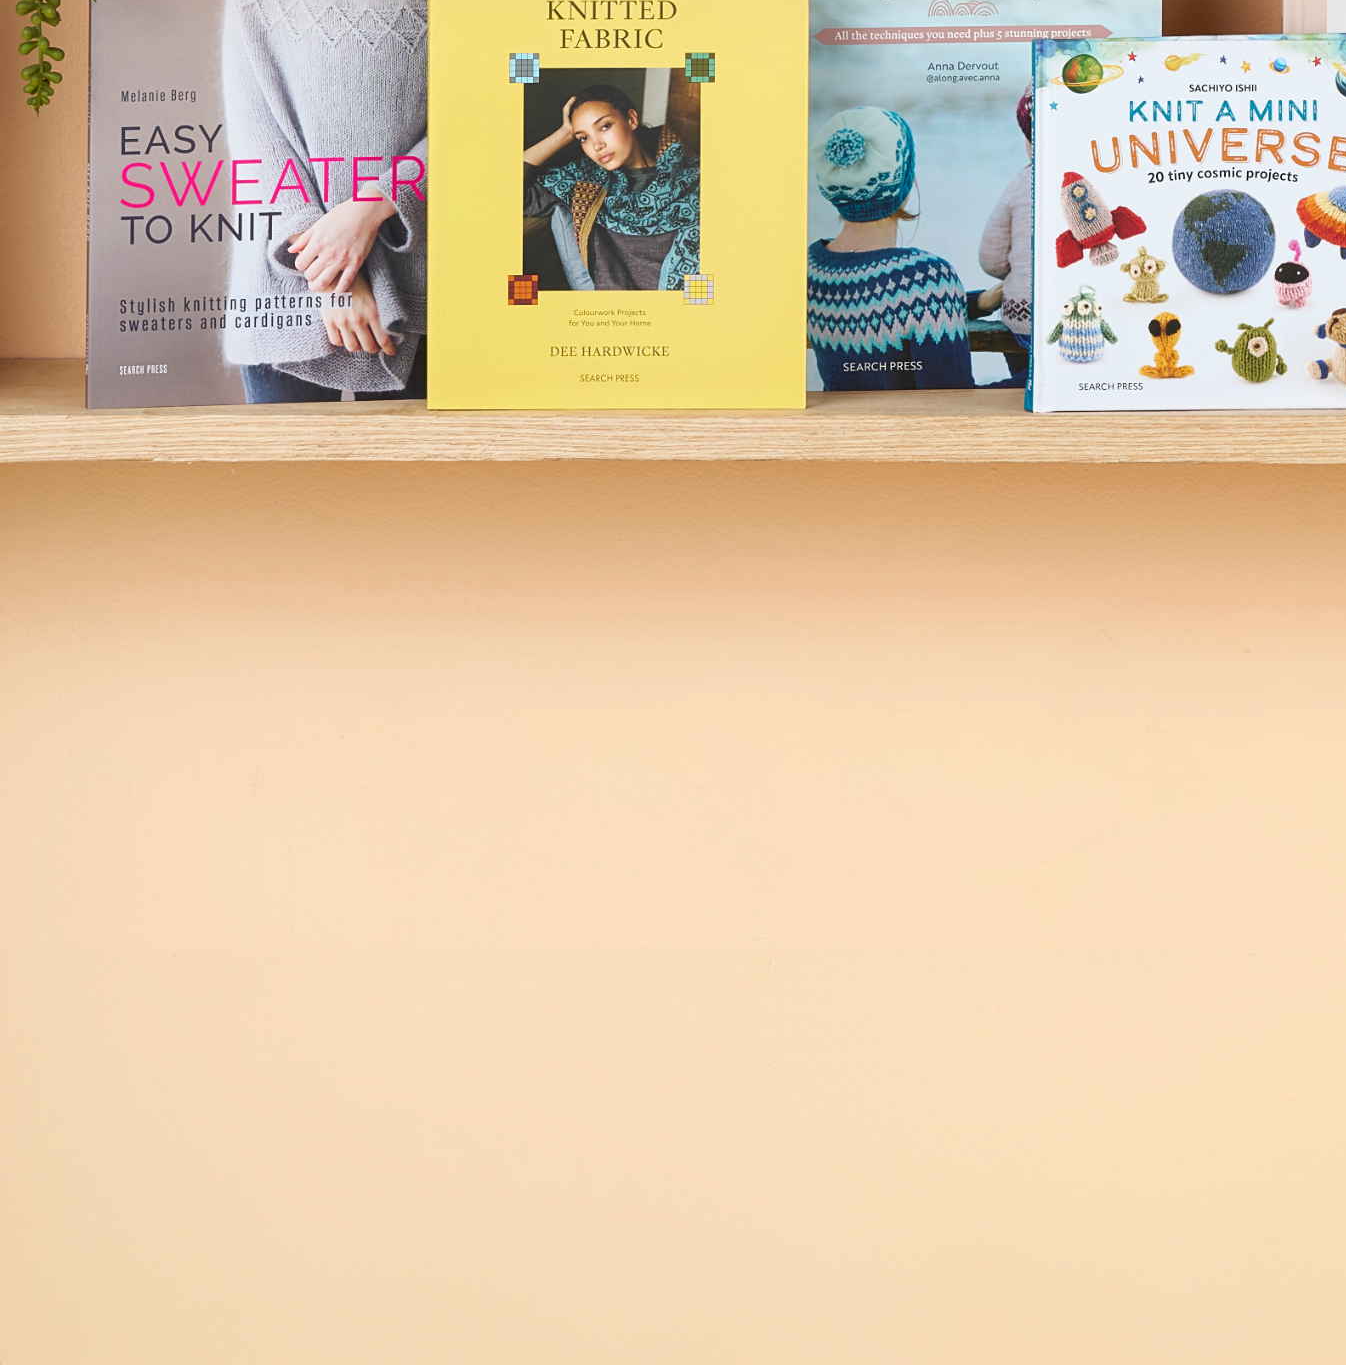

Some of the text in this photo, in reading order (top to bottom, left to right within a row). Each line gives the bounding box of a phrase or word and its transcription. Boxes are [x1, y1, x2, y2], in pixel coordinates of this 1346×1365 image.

[547, 0, 677, 20] KNITTED
[559, 29, 663, 49] FABRIC
[835, 28, 1092, 42] All the techniques you need plus 5 stunning projects
[928, 62, 999, 71] Anna Dervout
[1189, 84, 1257, 92] SACHIYO ISHII
[121, 89, 196, 103] Melanie Berg
[1128, 100, 1318, 122] KNIT A MINI
[121, 124, 223, 155] EASY
[1148, 168, 1298, 183] 20 tiny cosmic projects
[121, 212, 282, 245] TO KNIT
[617, 309, 646, 318] Projects
[120, 313, 312, 332] sweaters and cardigans
[550, 346, 670, 357] DEE HARDWICKE
